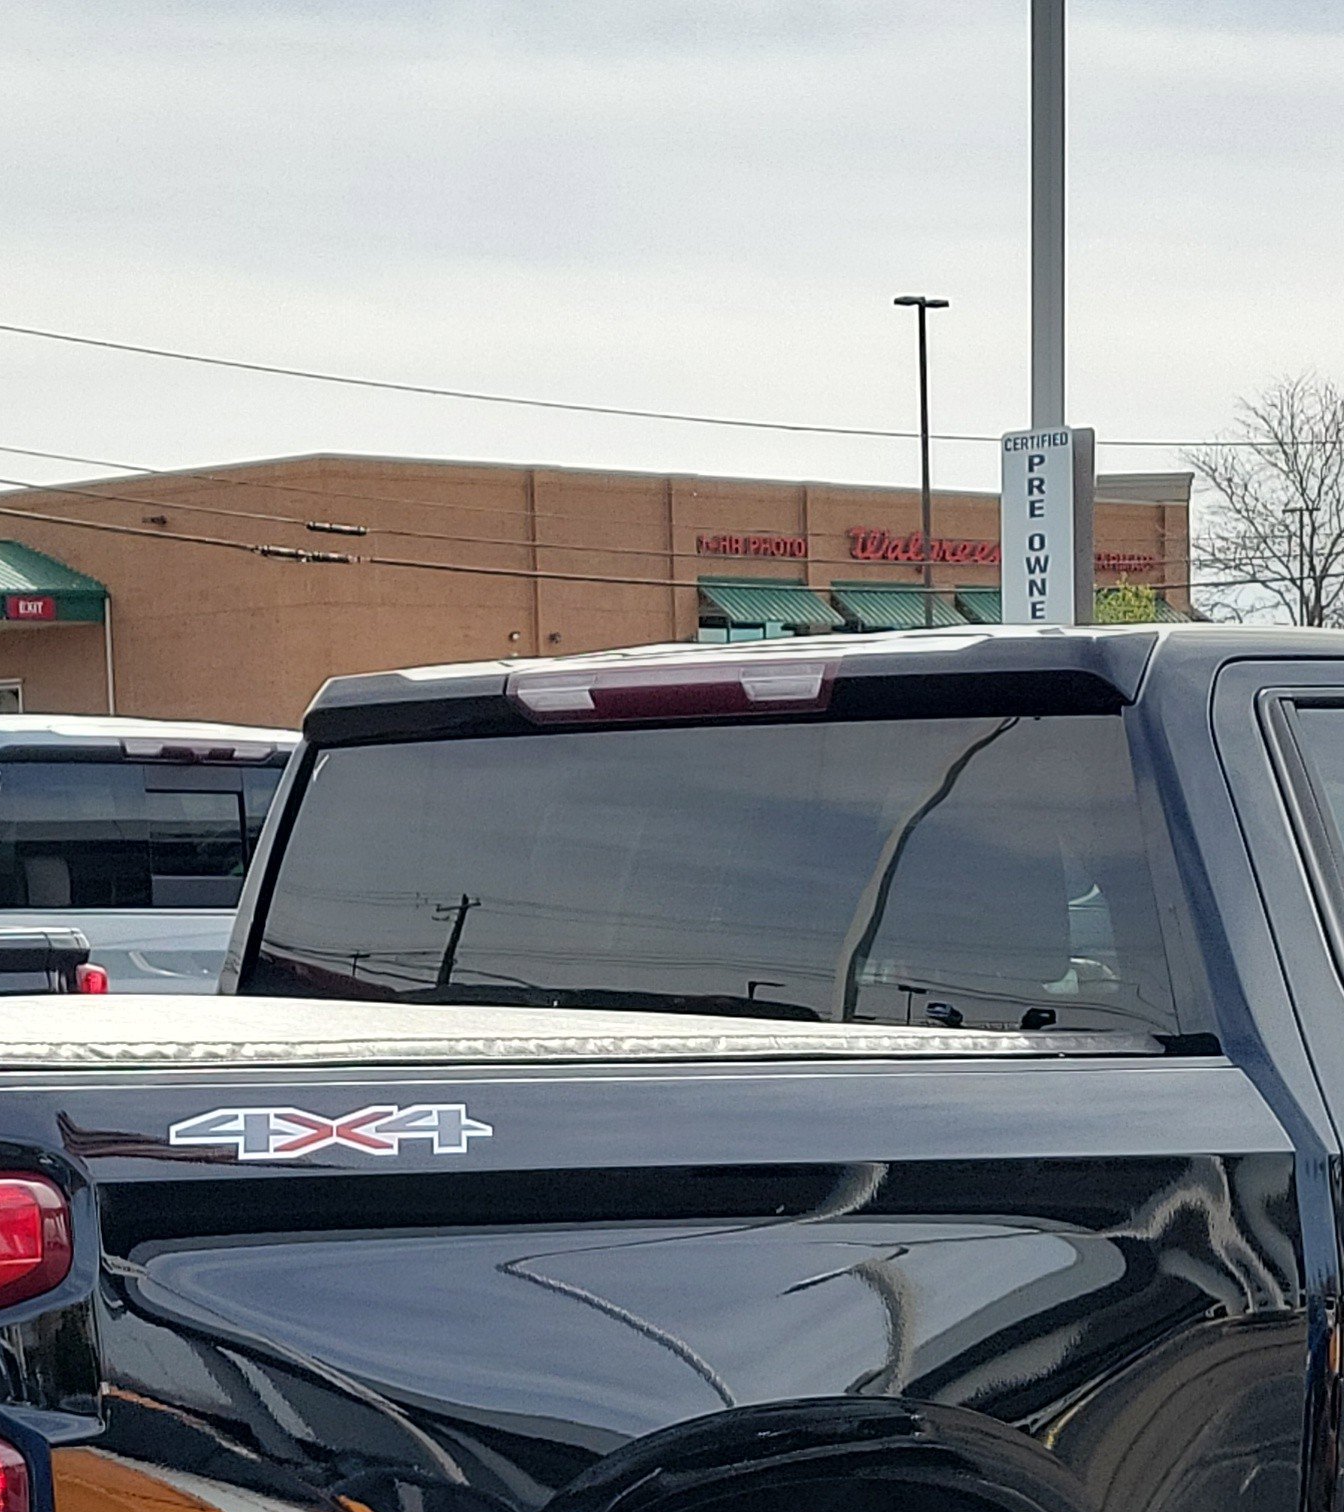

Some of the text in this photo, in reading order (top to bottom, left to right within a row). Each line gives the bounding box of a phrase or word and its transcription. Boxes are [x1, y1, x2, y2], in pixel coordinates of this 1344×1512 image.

[1004, 431, 1069, 452] CERTIFIED
[1027, 454, 1046, 519] PRE
[748, 535, 807, 558] PHOTO
[18, 600, 44, 615] EXIT
